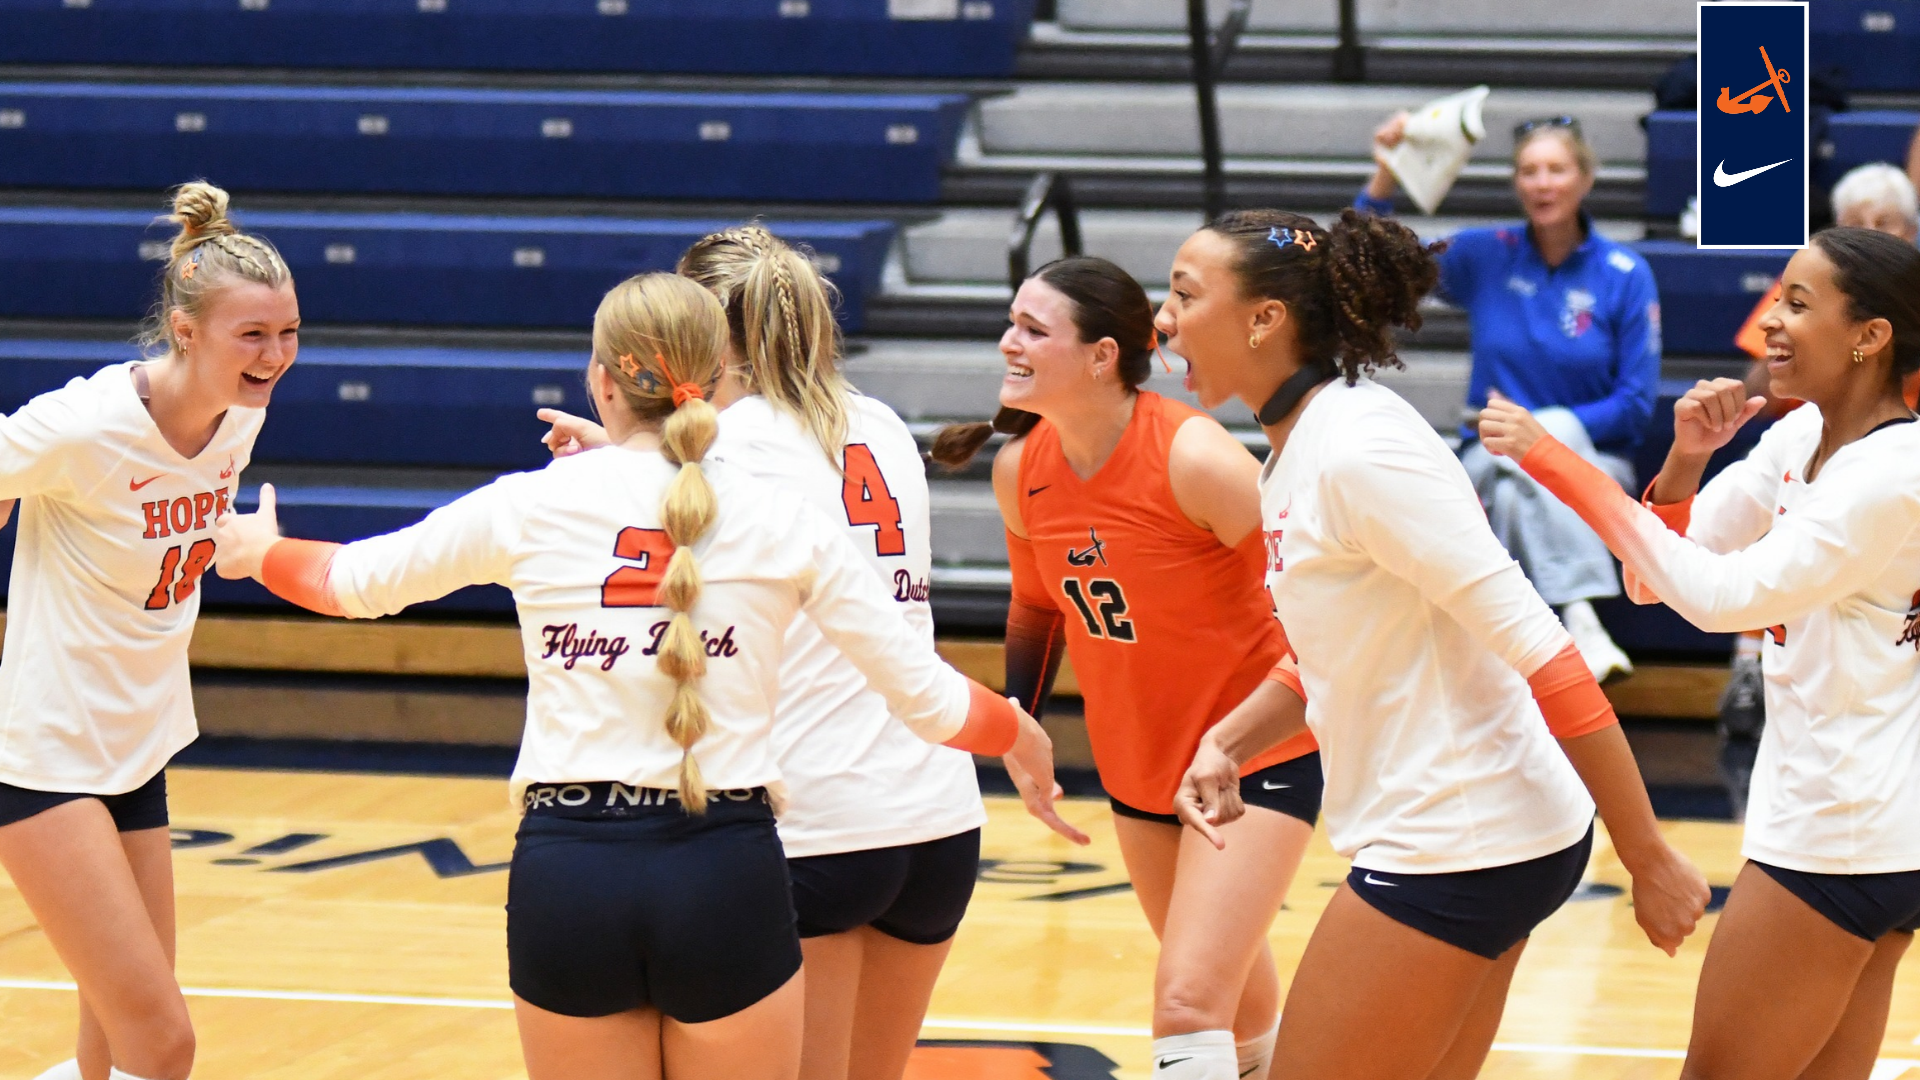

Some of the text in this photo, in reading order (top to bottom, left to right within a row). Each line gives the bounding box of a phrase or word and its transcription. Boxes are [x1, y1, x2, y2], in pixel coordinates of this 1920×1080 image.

[142, 486, 231, 539] HOPE
[841, 443, 906, 557] 4
[144, 538, 216, 611] 18
[601, 526, 676, 608] 2
[1061, 577, 1138, 643] 12
[541, 623, 630, 672] Flying
